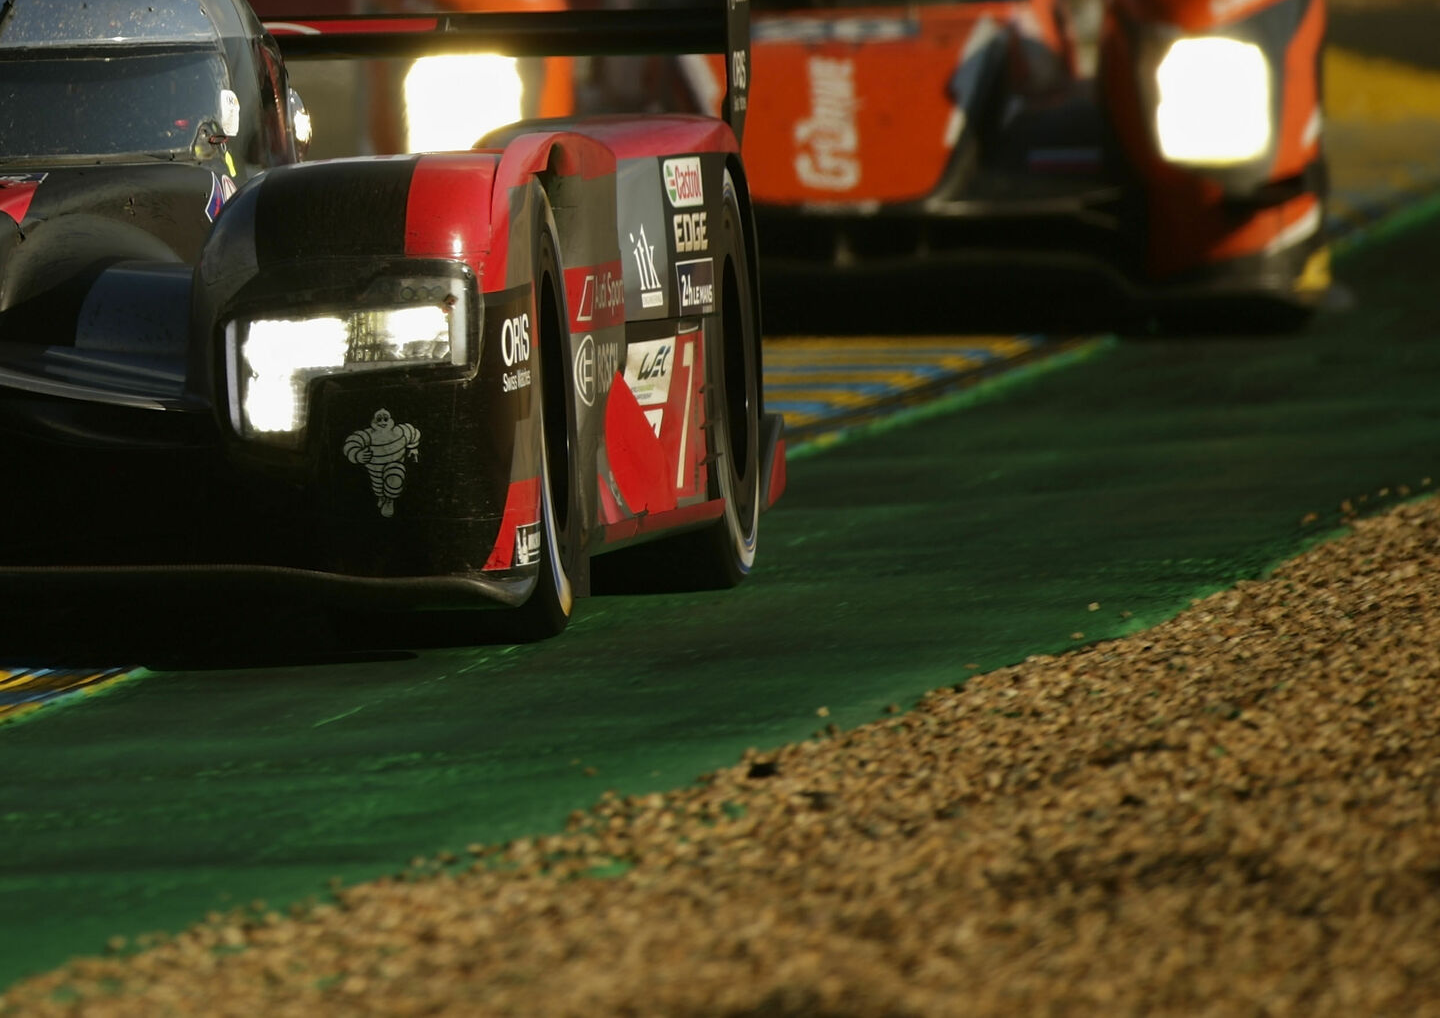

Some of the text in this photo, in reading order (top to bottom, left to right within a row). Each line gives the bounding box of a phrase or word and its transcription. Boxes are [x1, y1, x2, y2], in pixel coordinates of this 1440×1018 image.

[674, 164, 702, 200] Castrol
[672, 211, 709, 254] EDGE
[500, 313, 530, 367] ORIS
[637, 345, 672, 381] WEC
